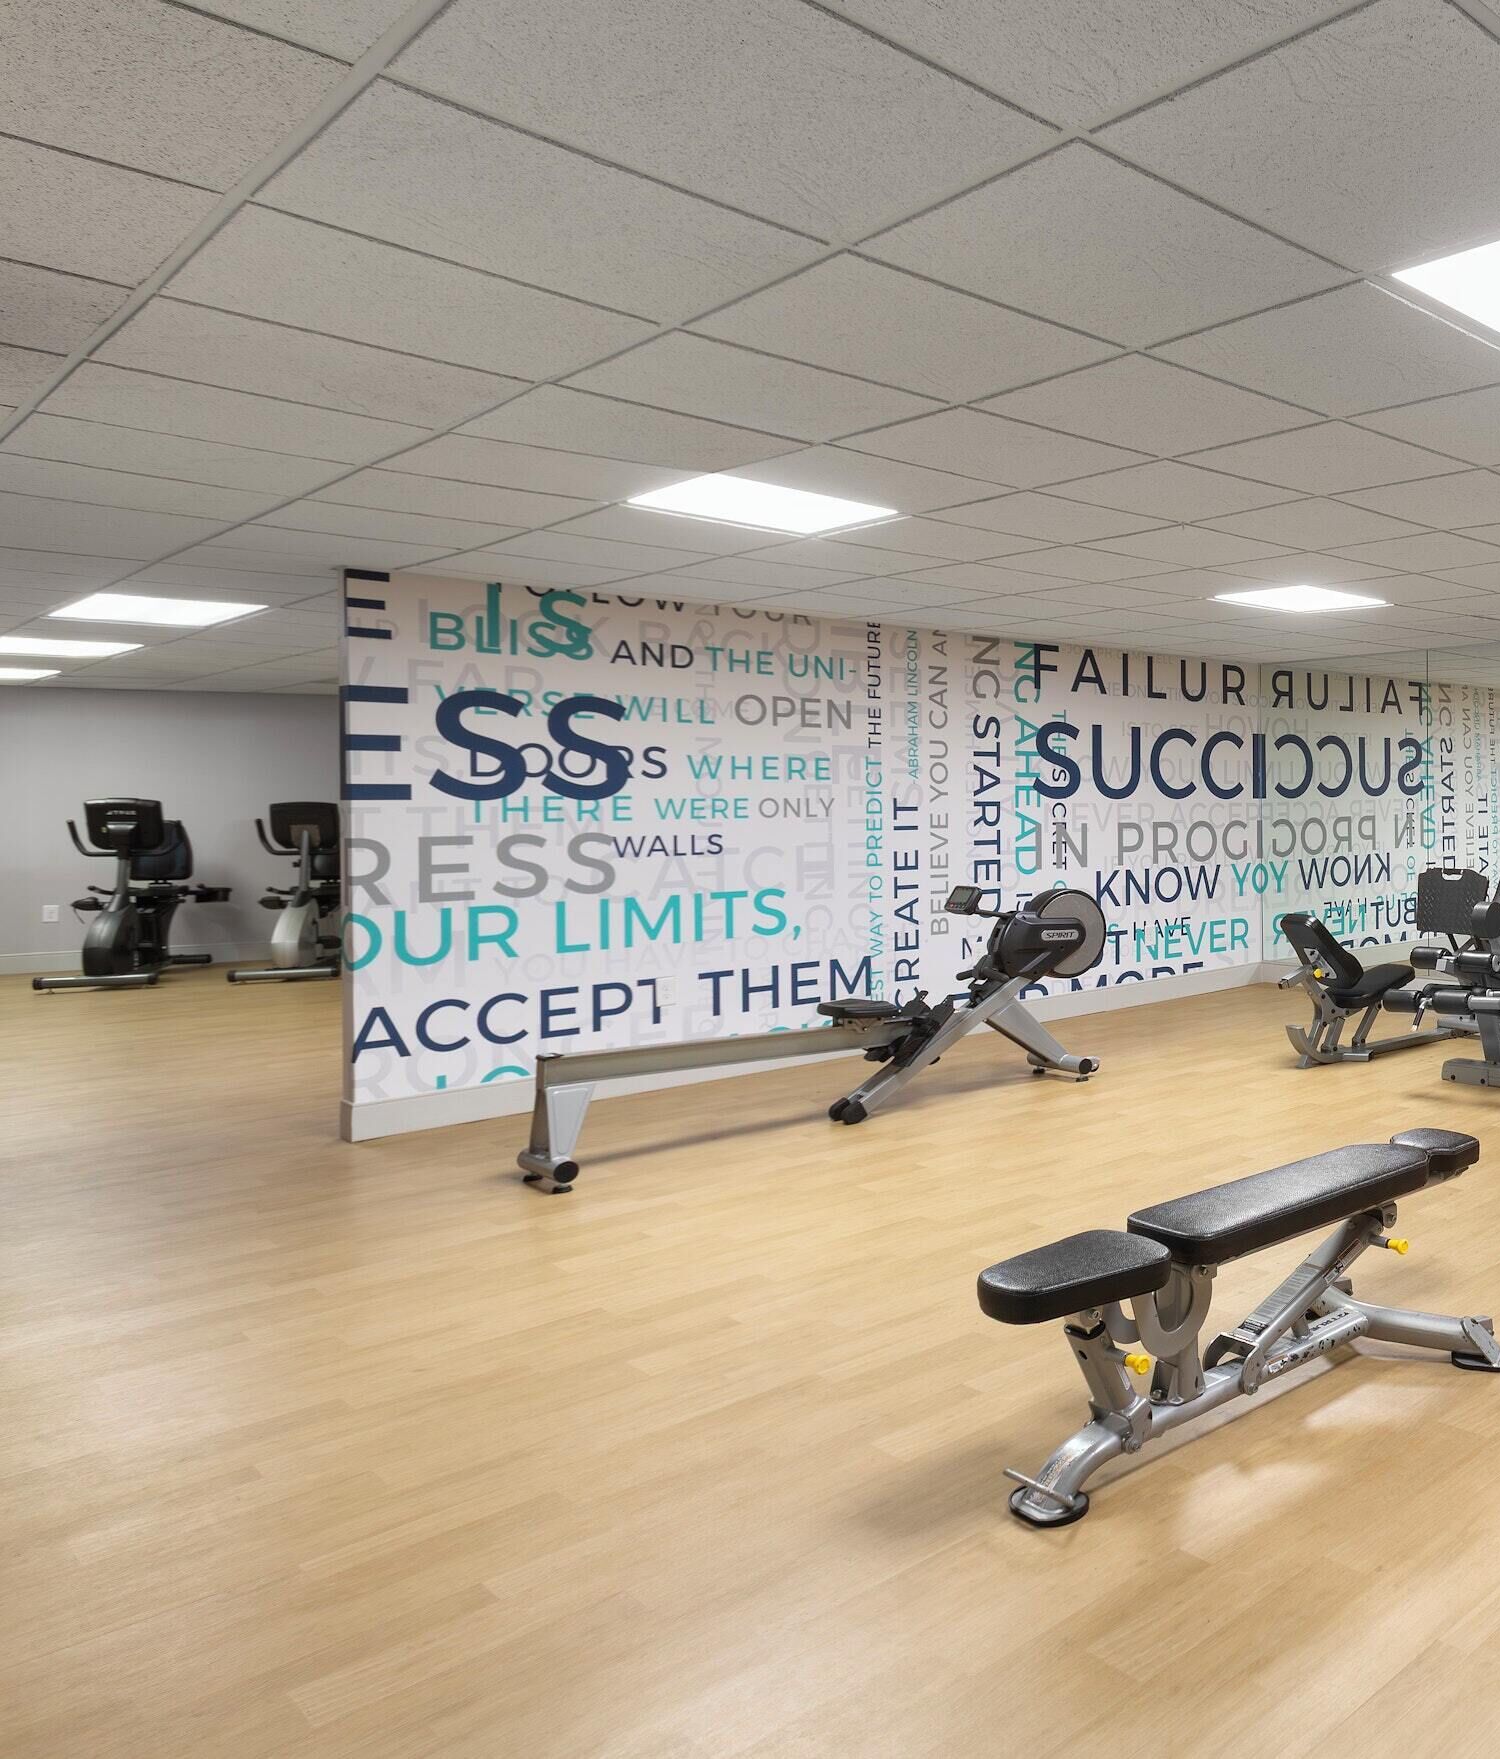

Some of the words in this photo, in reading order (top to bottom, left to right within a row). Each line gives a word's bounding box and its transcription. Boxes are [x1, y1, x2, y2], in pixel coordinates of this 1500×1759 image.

[429, 611, 594, 661] BLISS
[610, 639, 695, 669] AND
[704, 646, 775, 676] THE
[788, 653, 857, 681] UNI-
[867, 621, 882, 700] FUTURE
[906, 630, 918, 696] LINCOLN
[615, 694, 716, 725] WILL
[734, 694, 852, 730] OPEN
[928, 665, 948, 730] CAN
[867, 707, 882, 749] THE
[686, 755, 832, 781] WHERE
[929, 739, 949, 803] YOU
[1014, 713, 1041, 875] AHEAD
[469, 795, 633, 823] THERE
[654, 797, 749, 820] WERE
[758, 797, 835, 819] ONLY
[865, 755, 883, 867] PREDICT
[893, 797, 919, 831] IT
[972, 714, 1001, 916] STARTED
[613, 833, 724, 858] WALLS
[1036, 821, 1088, 870] IN
[868, 875, 883, 903] TO
[929, 812, 950, 936] BELIEVE
[1095, 864, 1221, 907] KNOW
[556, 888, 802, 954] LIMITS,
[869, 911, 884, 958] WAY
[893, 849, 920, 1008] CREATE
[1046, 931, 1076, 939] SPIRIT
[1135, 917, 1249, 963] NEVER
[352, 977, 661, 1064] ACCEPT
[698, 955, 872, 1017] THEM
